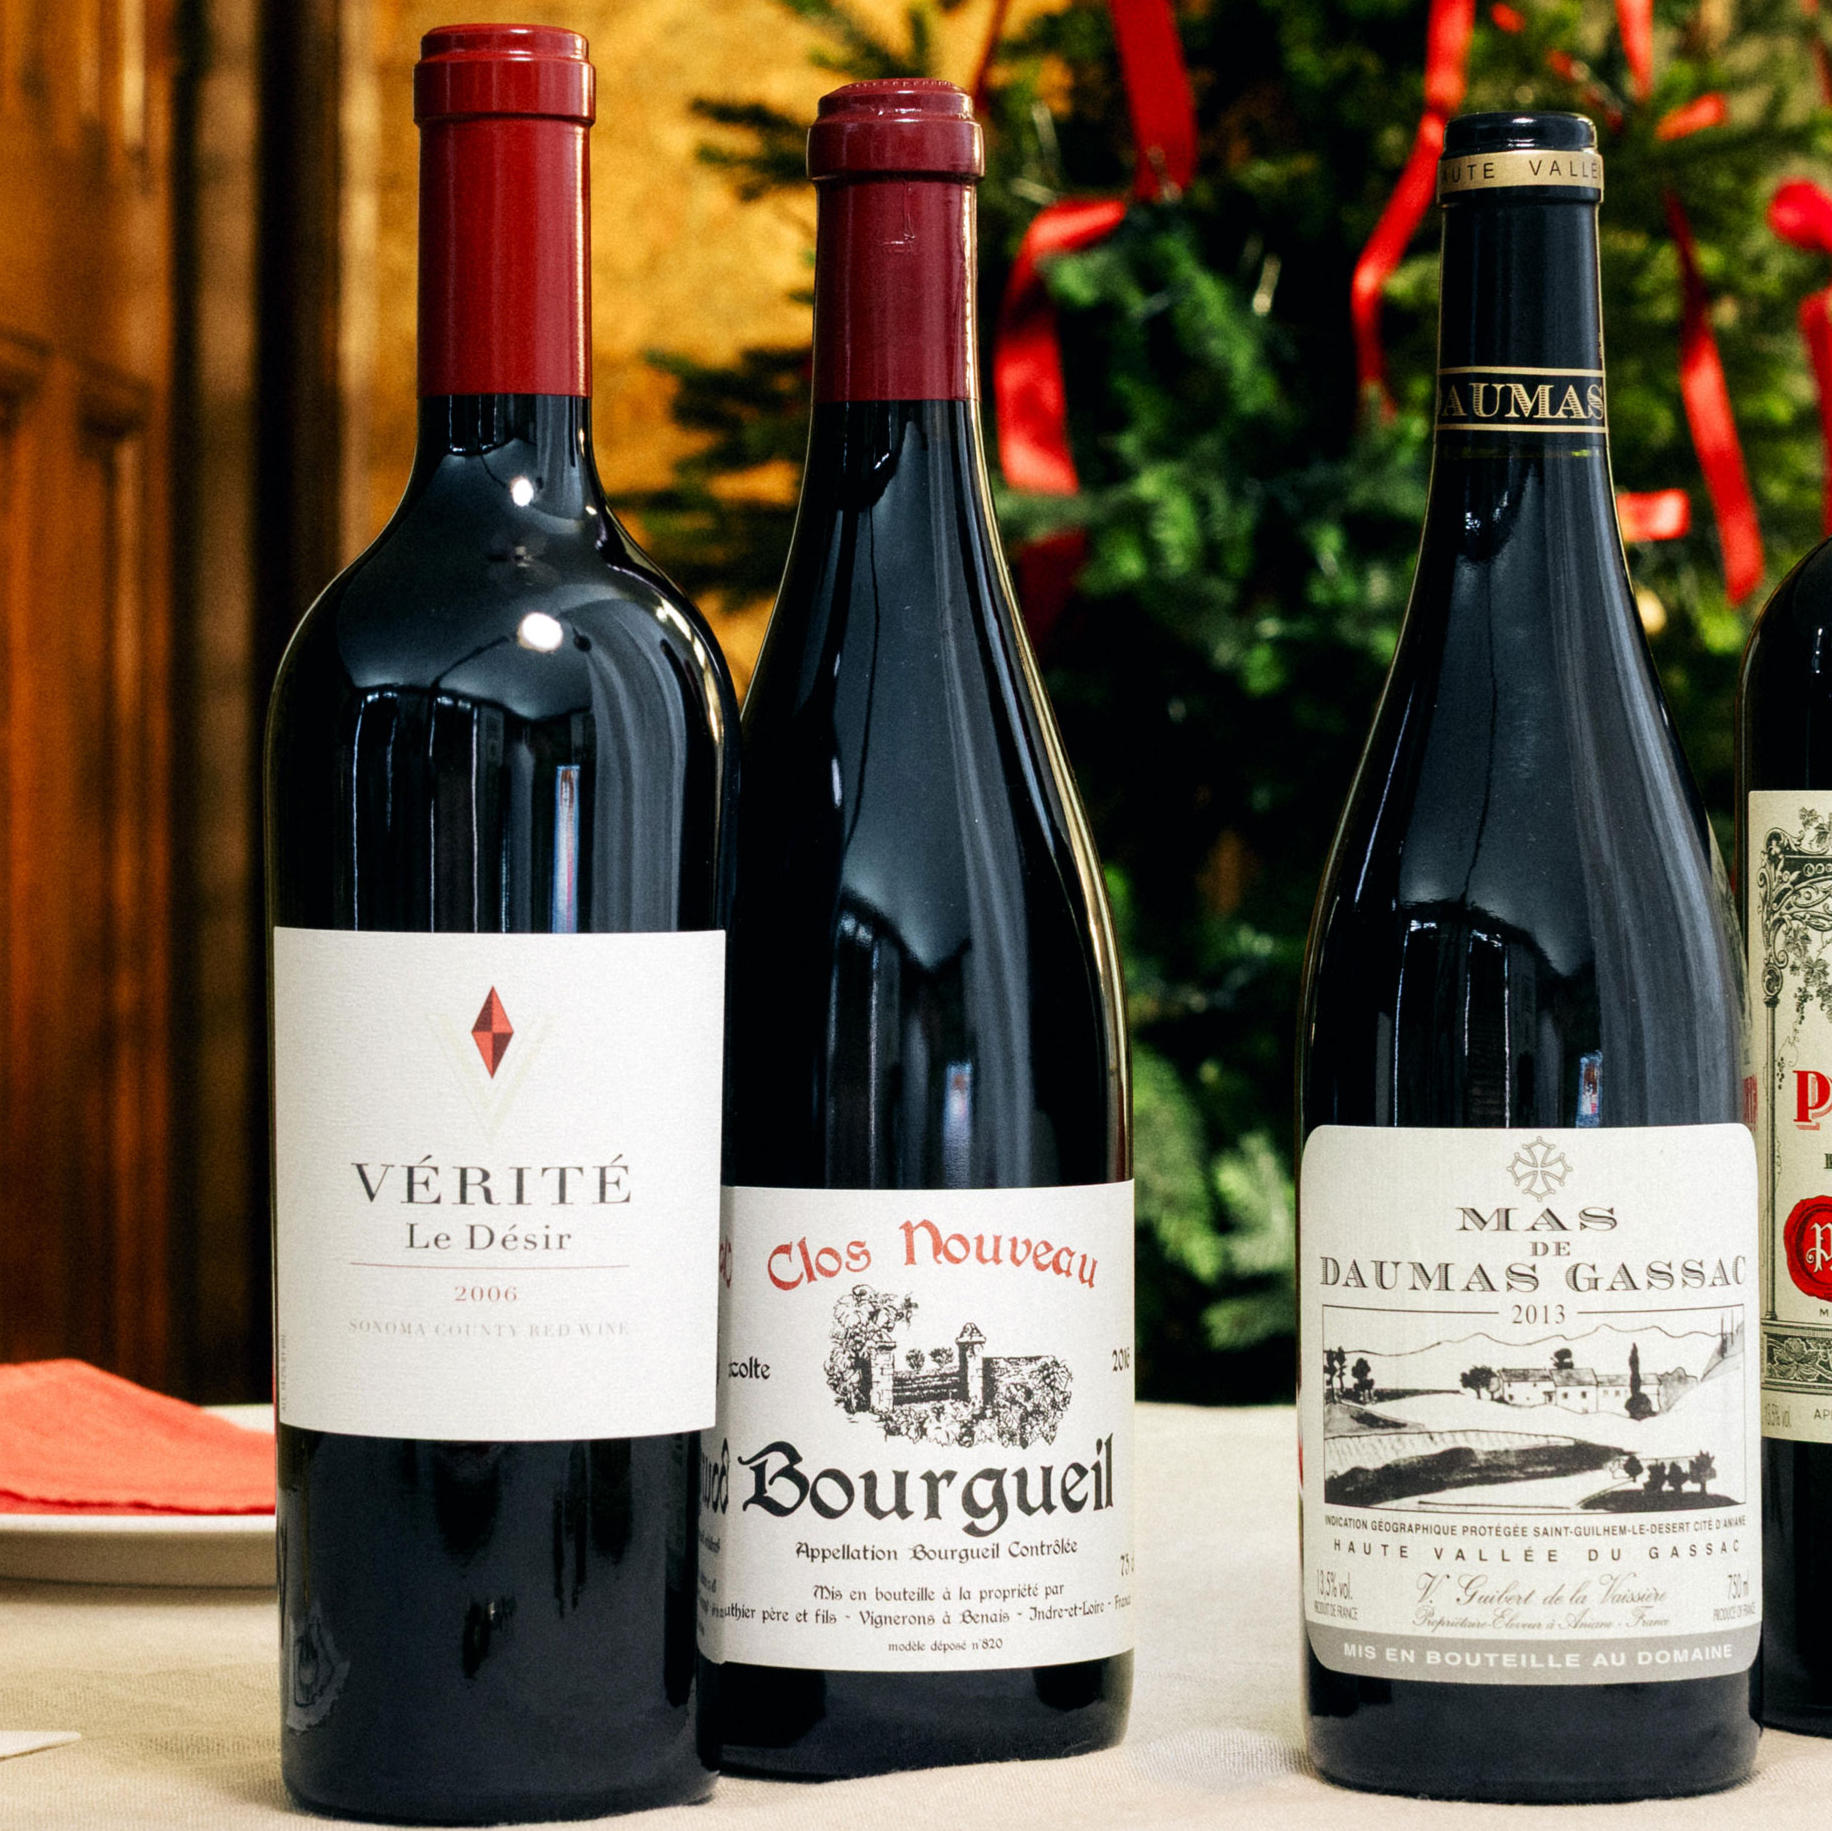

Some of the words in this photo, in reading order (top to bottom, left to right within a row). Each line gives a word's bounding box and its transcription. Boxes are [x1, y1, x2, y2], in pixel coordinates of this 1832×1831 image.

[351, 1153, 631, 1205] VÉRITÉ
[1456, 1207, 1618, 1232] MAS
[405, 1223, 452, 1250] Le
[464, 1224, 572, 1251] Désir
[1530, 1241, 1571, 1257] DE
[767, 1237, 872, 1291] Clos
[899, 1219, 1098, 1290] Nouveau
[1320, 1256, 1540, 1293] DAUMAS
[1566, 1255, 1746, 1292] GASSAC
[454, 1286, 519, 1303] 2006
[1512, 1304, 1566, 1325] 2013
[350, 1320, 425, 1336] SONOMA
[434, 1322, 517, 1337] COUNTY
[528, 1323, 570, 1337] RED
[578, 1322, 630, 1336] WINE
[738, 1433, 1114, 1538] Bourgueil
[1325, 1515, 1367, 1530] INDICATION
[1371, 1518, 1457, 1536] GÉOGRAPHIQUE
[1462, 1523, 1528, 1537] PROTÉGÉE
[796, 1542, 898, 1563] Appellation
[909, 1543, 1000, 1564] Bourgueil
[1008, 1538, 1078, 1559] Contrôlée
[1334, 1539, 1408, 1558] HAUTE
[1434, 1546, 1558, 1562] VALLÉE
[1588, 1548, 1621, 1562] DU
[1649, 1539, 1740, 1560] GASSAC
[813, 1584, 843, 1600] Mis
[850, 1588, 867, 1601] en
[875, 1584, 935, 1601] bouteille
[942, 1586, 952, 1601] à
[959, 1585, 971, 1601] la
[979, 1582, 1039, 1603] propriété
[1045, 1584, 1065, 1601] par
[1456, 1574, 1536, 1607] Guibert
[1542, 1583, 1566, 1605] de
[1569, 1581, 1591, 1604] la
[762, 1606, 789, 1624] père
[795, 1608, 808, 1623] et
[815, 1609, 837, 1625] fils
[859, 1611, 935, 1629] Vignerons
[942, 1610, 952, 1625] à
[958, 1611, 1010, 1625] Benais
[1029, 1600, 1105, 1623] Indre-et-Loire
[888, 1640, 926, 1652] modèle
[930, 1639, 967, 1653] déposé
[1343, 1642, 1377, 1659] MIS
[1385, 1647, 1416, 1664] EN
[1426, 1651, 1581, 1668] BOUTEILLE
[1592, 1650, 1626, 1667] AU
[1637, 1644, 1733, 1665] DOMAINE
